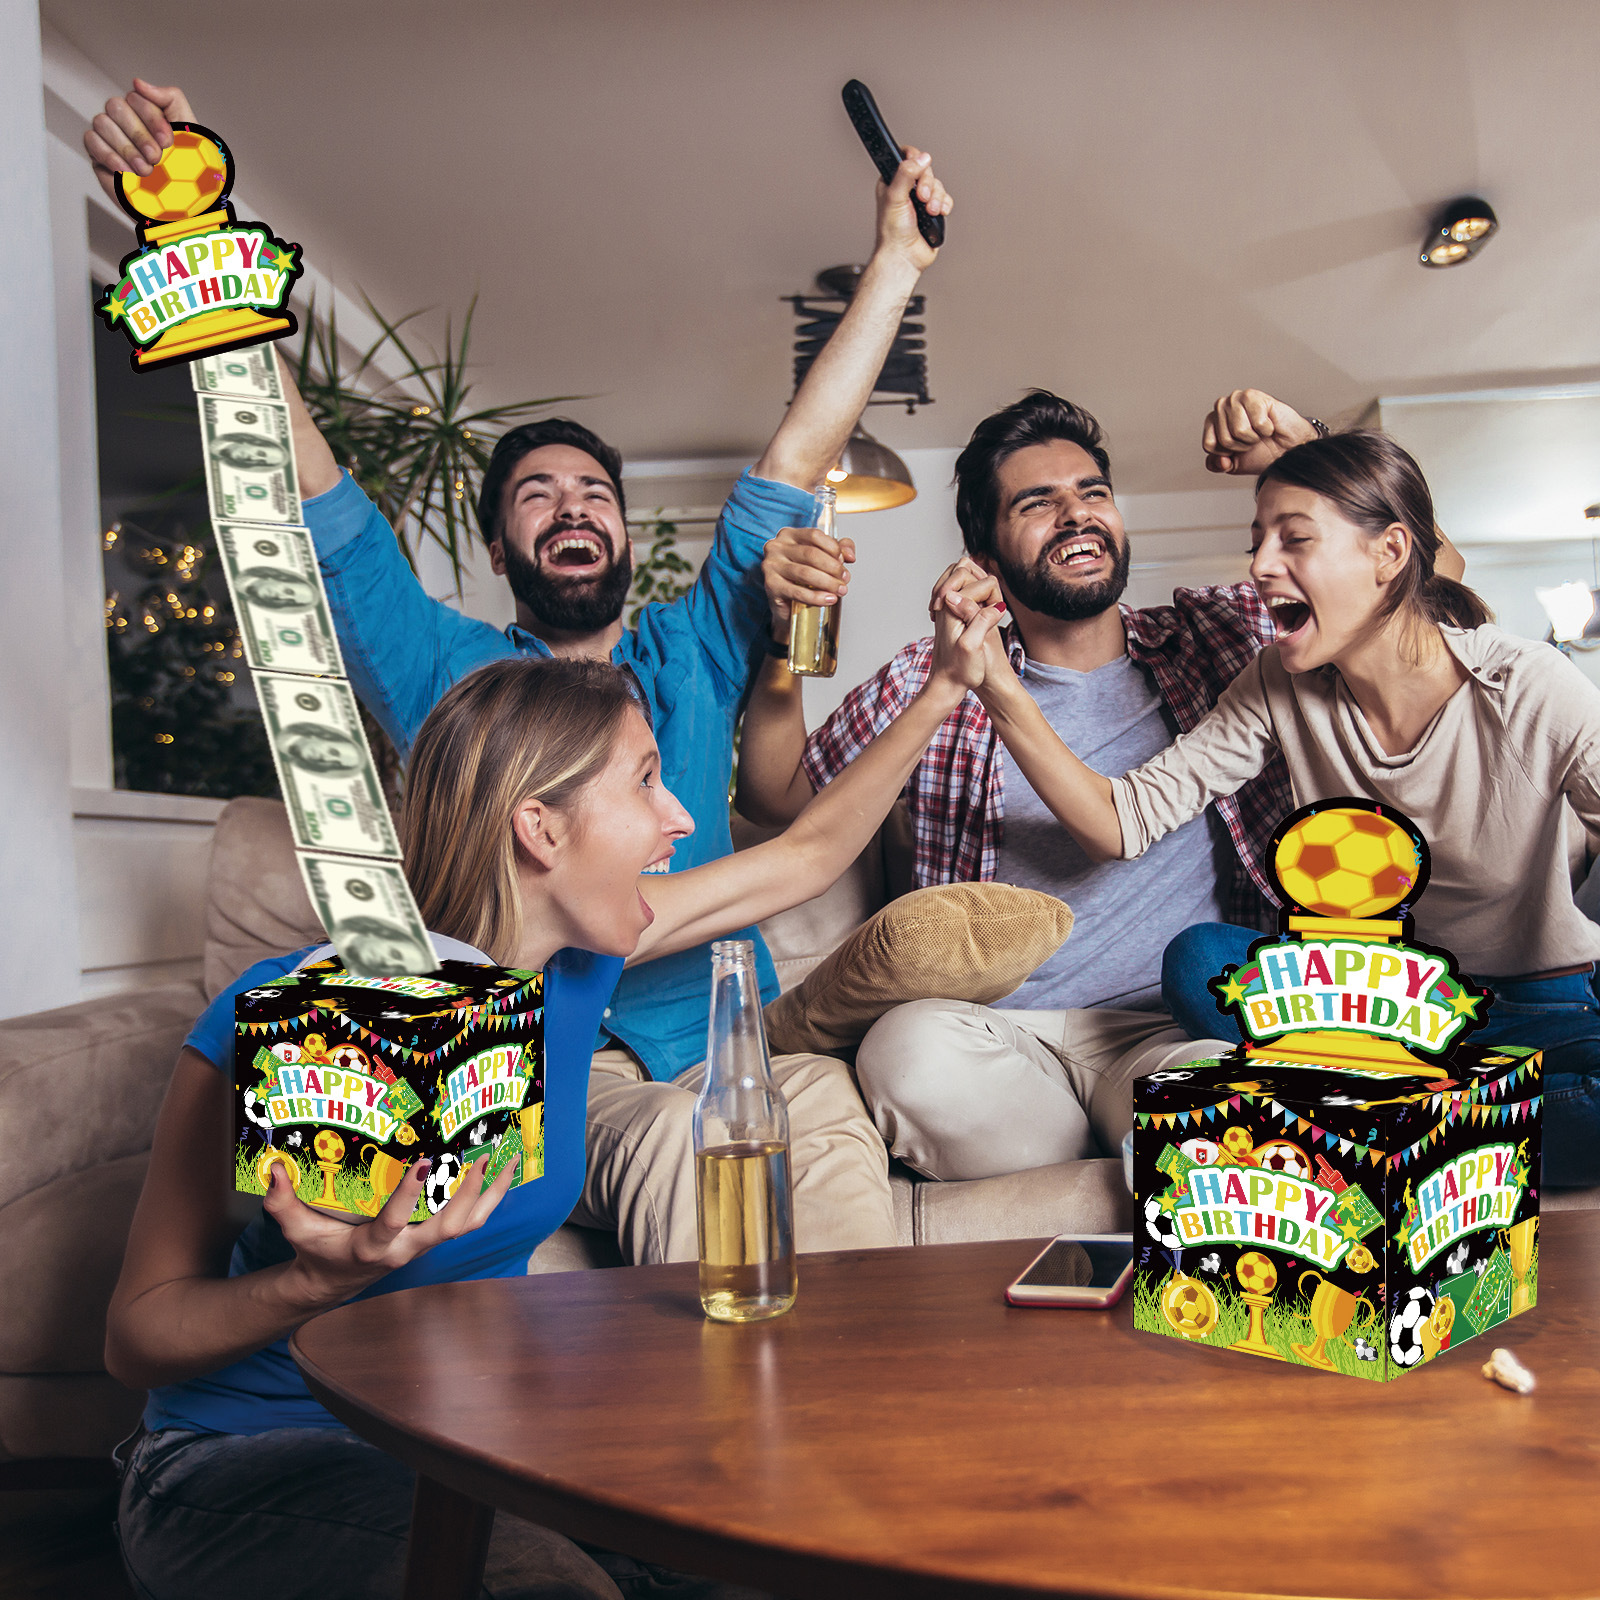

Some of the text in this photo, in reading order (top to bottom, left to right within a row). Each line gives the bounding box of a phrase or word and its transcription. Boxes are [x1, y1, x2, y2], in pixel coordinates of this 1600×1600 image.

[135, 237, 258, 296] HAPPY
[131, 274, 284, 335] BIRTHDAY
[1266, 949, 1436, 999] HAPPY
[1250, 993, 1451, 1043] BIRTHDAY
[282, 1068, 383, 1107] HAPPY
[451, 1050, 519, 1099] HAPPY
[272, 1098, 396, 1137] BIRTHDAY
[443, 1079, 526, 1136] BIRTHDAY
[1194, 1174, 1328, 1224] HAPPY
[1421, 1152, 1510, 1212] HAPPY
[1181, 1210, 1346, 1262] BIRTHDAY
[1412, 1186, 1519, 1261] BIRTHDAY
